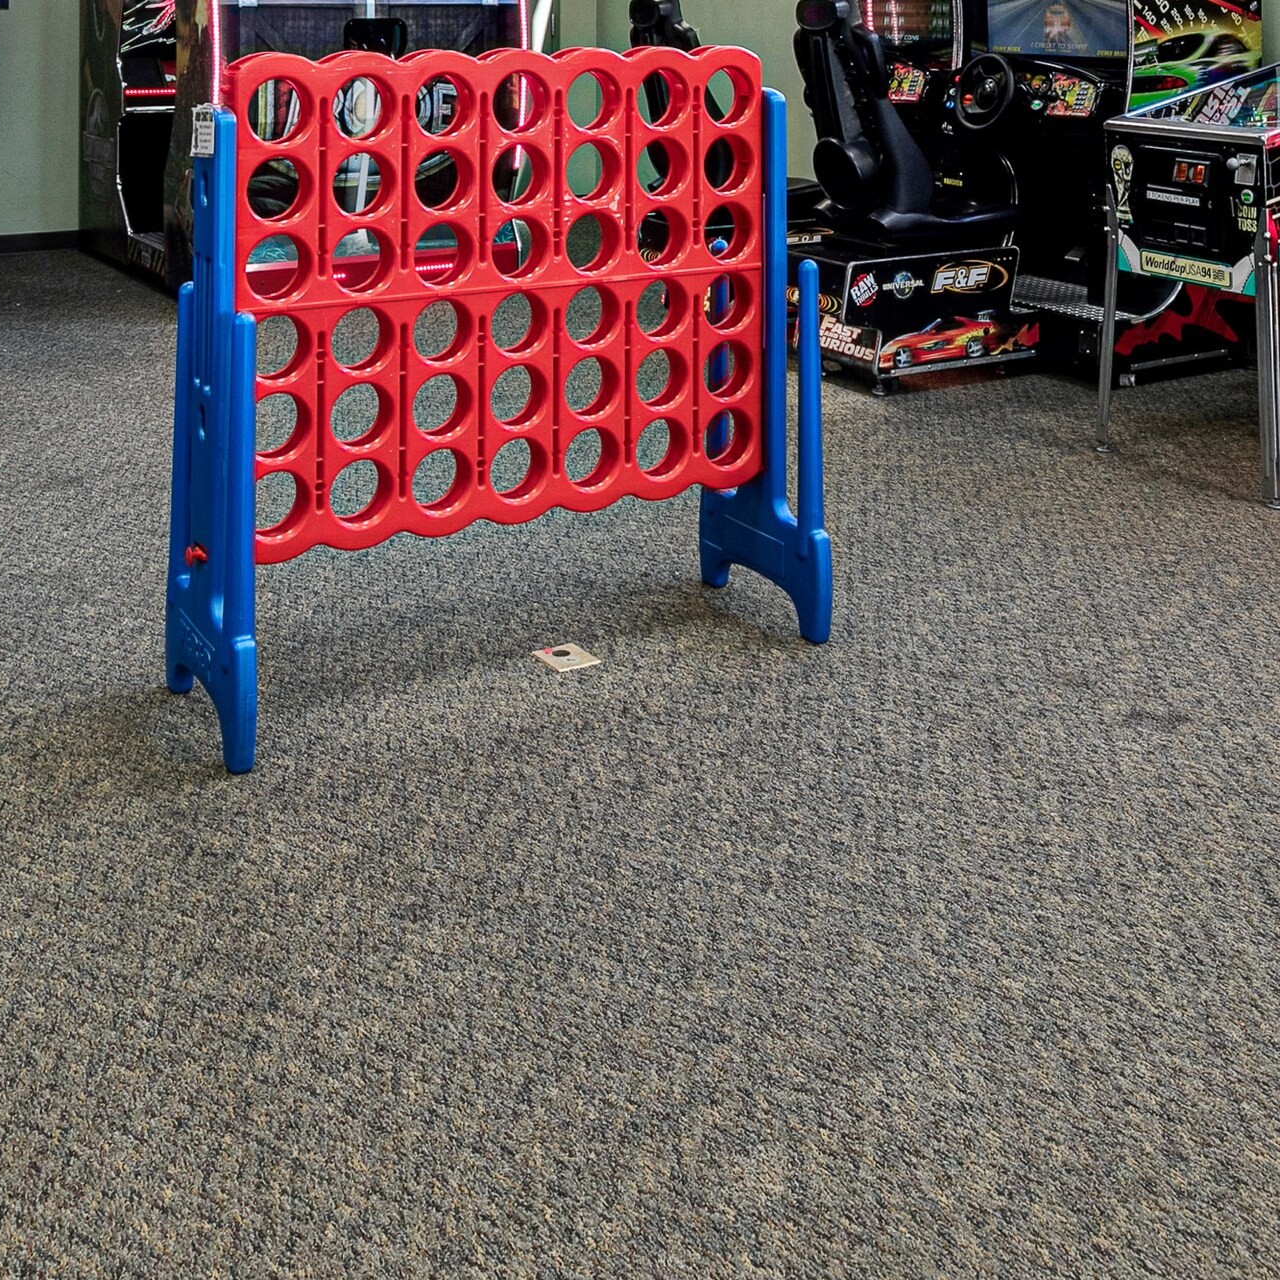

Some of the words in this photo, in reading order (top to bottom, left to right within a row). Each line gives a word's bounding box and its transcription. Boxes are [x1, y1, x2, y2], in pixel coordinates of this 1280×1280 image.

[1238, 206, 1257, 219] COIN
[1237, 218, 1257, 232] TOSS
[850, 273, 875, 299] RAW
[882, 279, 925, 291] UNIVERSAL
[931, 265, 992, 294] F&F
[855, 283, 879, 306] THRILLS
[822, 314, 862, 339] FAST
[820, 336, 875, 361] URIOUS
